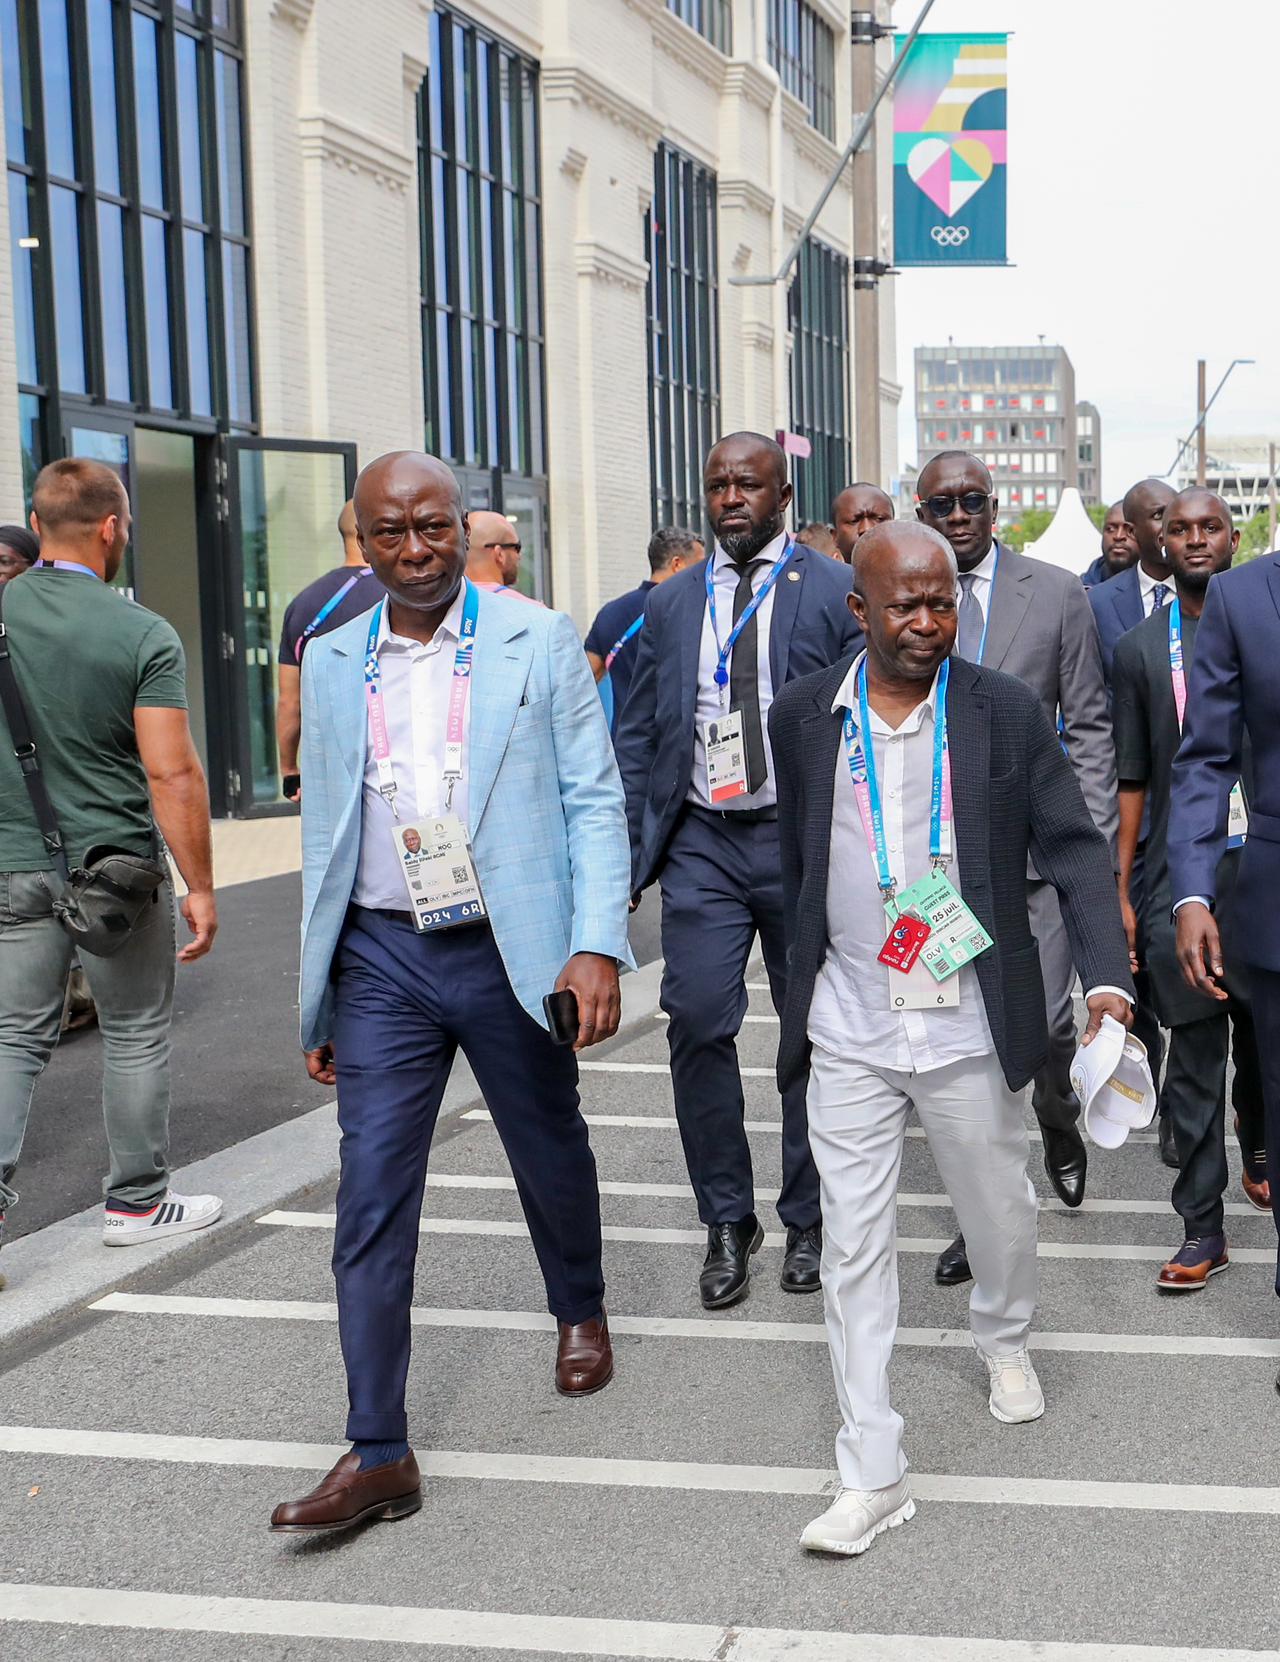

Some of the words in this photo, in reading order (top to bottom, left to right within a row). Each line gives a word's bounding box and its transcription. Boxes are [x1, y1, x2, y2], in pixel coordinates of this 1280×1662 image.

[740, 783, 744, 792] R
[462, 904, 480, 916] 6R
[931, 910, 944, 923] 25
[941, 899, 960, 917] juil.
[925, 946, 942, 960] OLV
[937, 994, 944, 1004] 6
